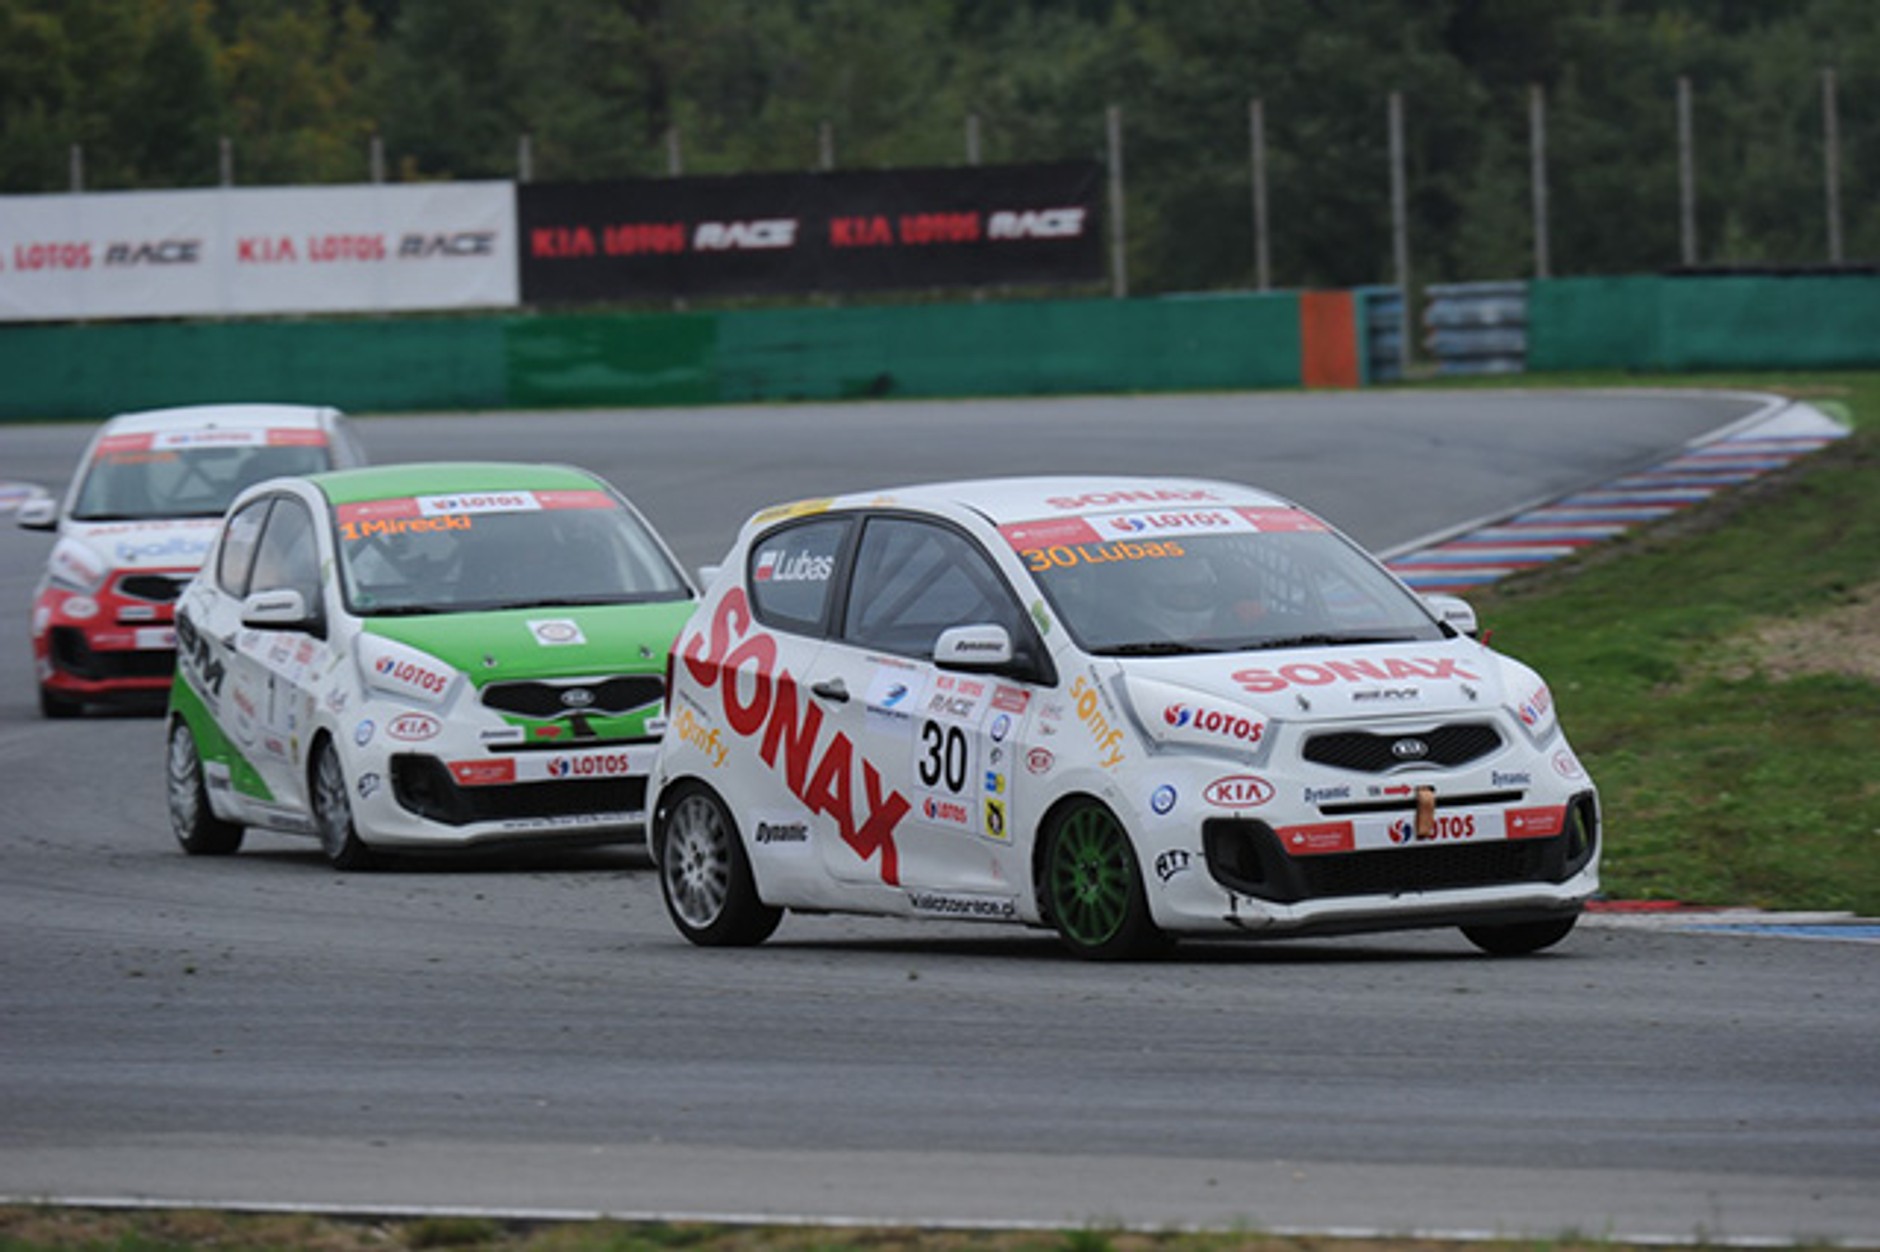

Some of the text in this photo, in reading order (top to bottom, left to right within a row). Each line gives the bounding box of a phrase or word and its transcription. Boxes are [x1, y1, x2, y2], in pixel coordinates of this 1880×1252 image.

[532, 219, 797, 256] KIA LOTOS RACE
[831, 207, 1085, 246] KIA LOTOS RACE
[14, 242, 93, 270] LOTOS
[104, 238, 201, 266] RACE
[237, 230, 496, 263] KIA LOTOS RACE
[460, 495, 524, 509] LOTOS
[1046, 488, 1222, 510] SONAX
[1146, 510, 1232, 529] LOTOS
[773, 550, 834, 580] Lubas
[1079, 540, 1185, 564] Lubas
[393, 660, 448, 694] LOTOS
[1231, 658, 1482, 693] SONAX
[683, 586, 912, 888] SONAX
[1069, 675, 1125, 768] somfy
[1193, 708, 1264, 743] LOTOS
[572, 754, 629, 775] LOTOS
[919, 719, 968, 794] 30
[1216, 782, 1263, 801] KIA
[755, 822, 809, 844] Dynamic
[1425, 814, 1475, 841] OTOS
